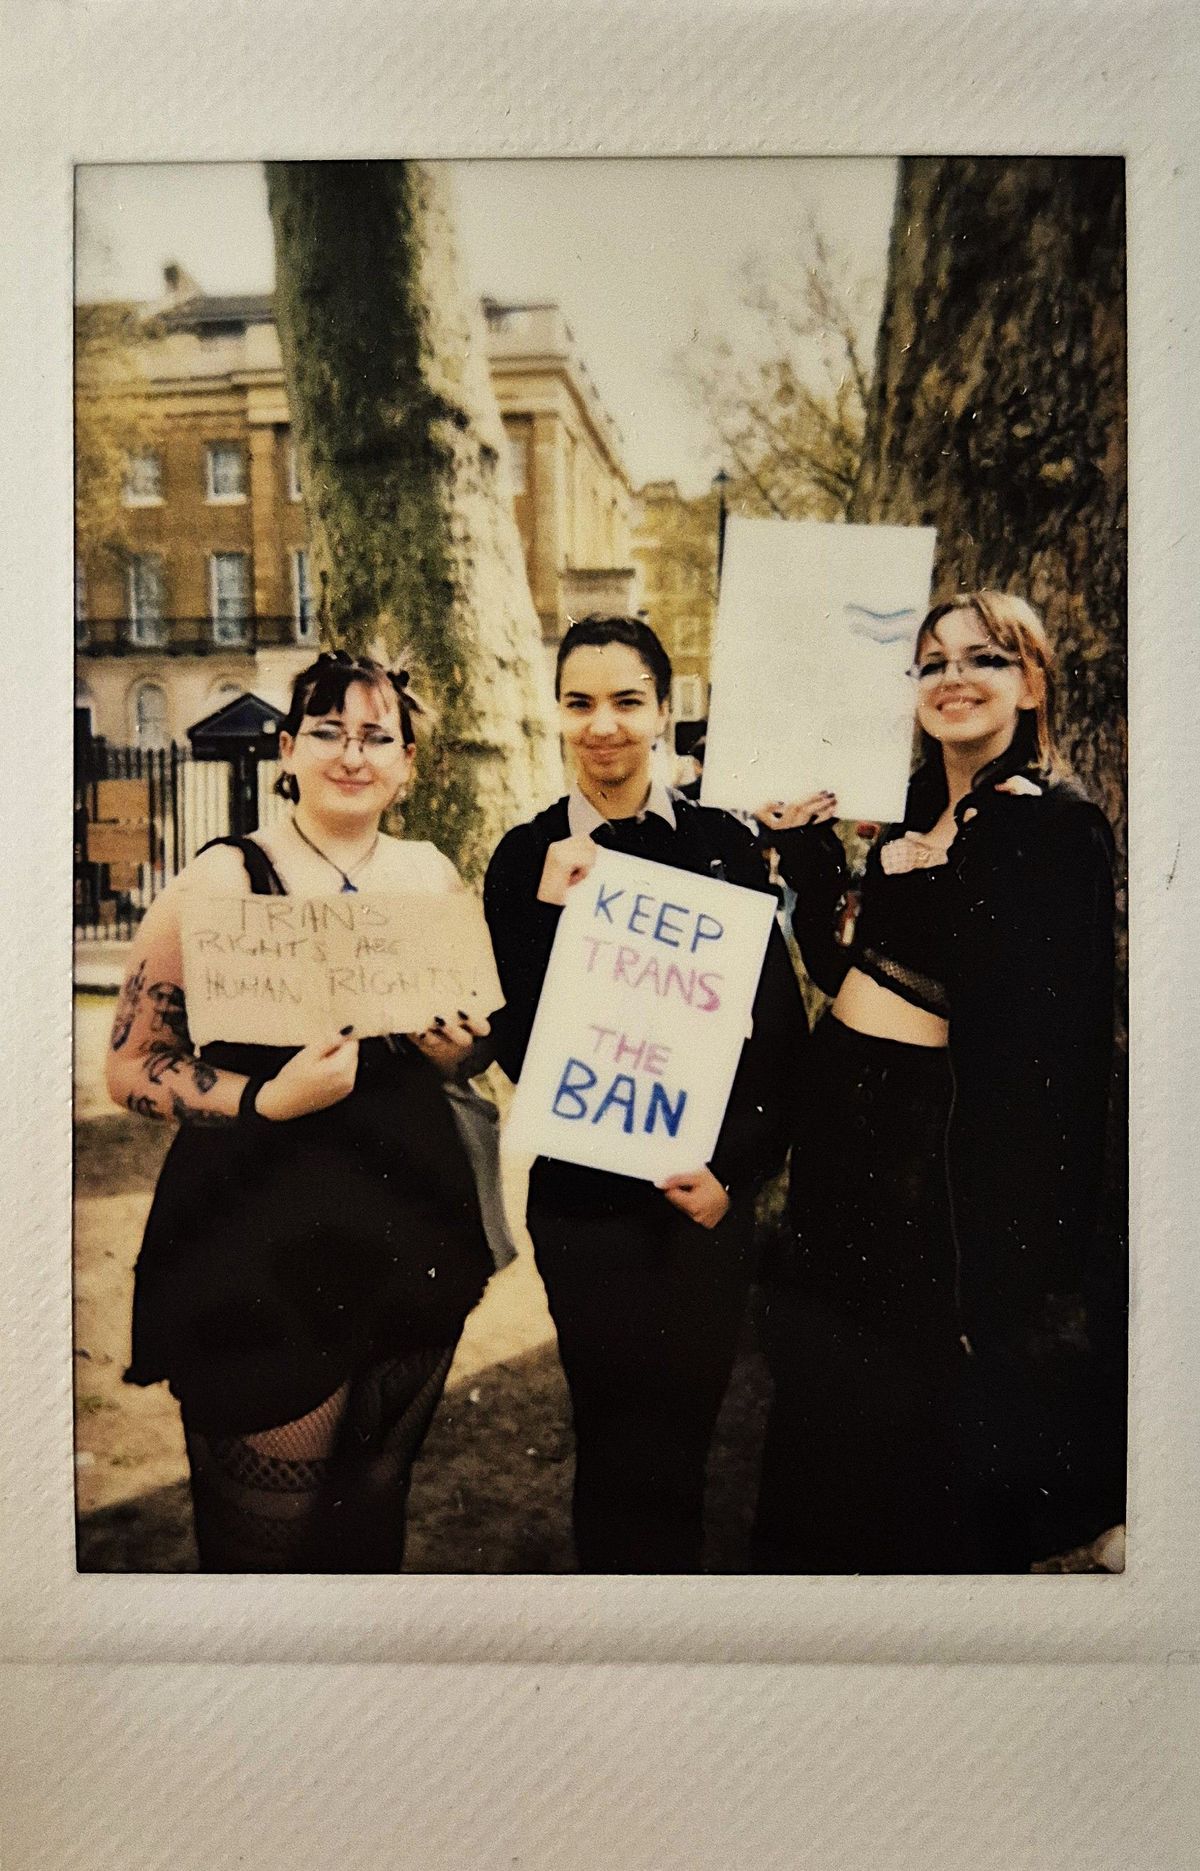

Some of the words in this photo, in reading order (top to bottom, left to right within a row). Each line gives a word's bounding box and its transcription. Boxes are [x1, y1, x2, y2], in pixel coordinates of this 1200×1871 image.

[240, 899, 388, 933] TRANS
[594, 884, 724, 953] KEEP
[206, 966, 301, 1003] HUMAN
[582, 935, 724, 1012] TRANS
[590, 1023, 672, 1075] THE
[551, 1056, 688, 1137] BAN
